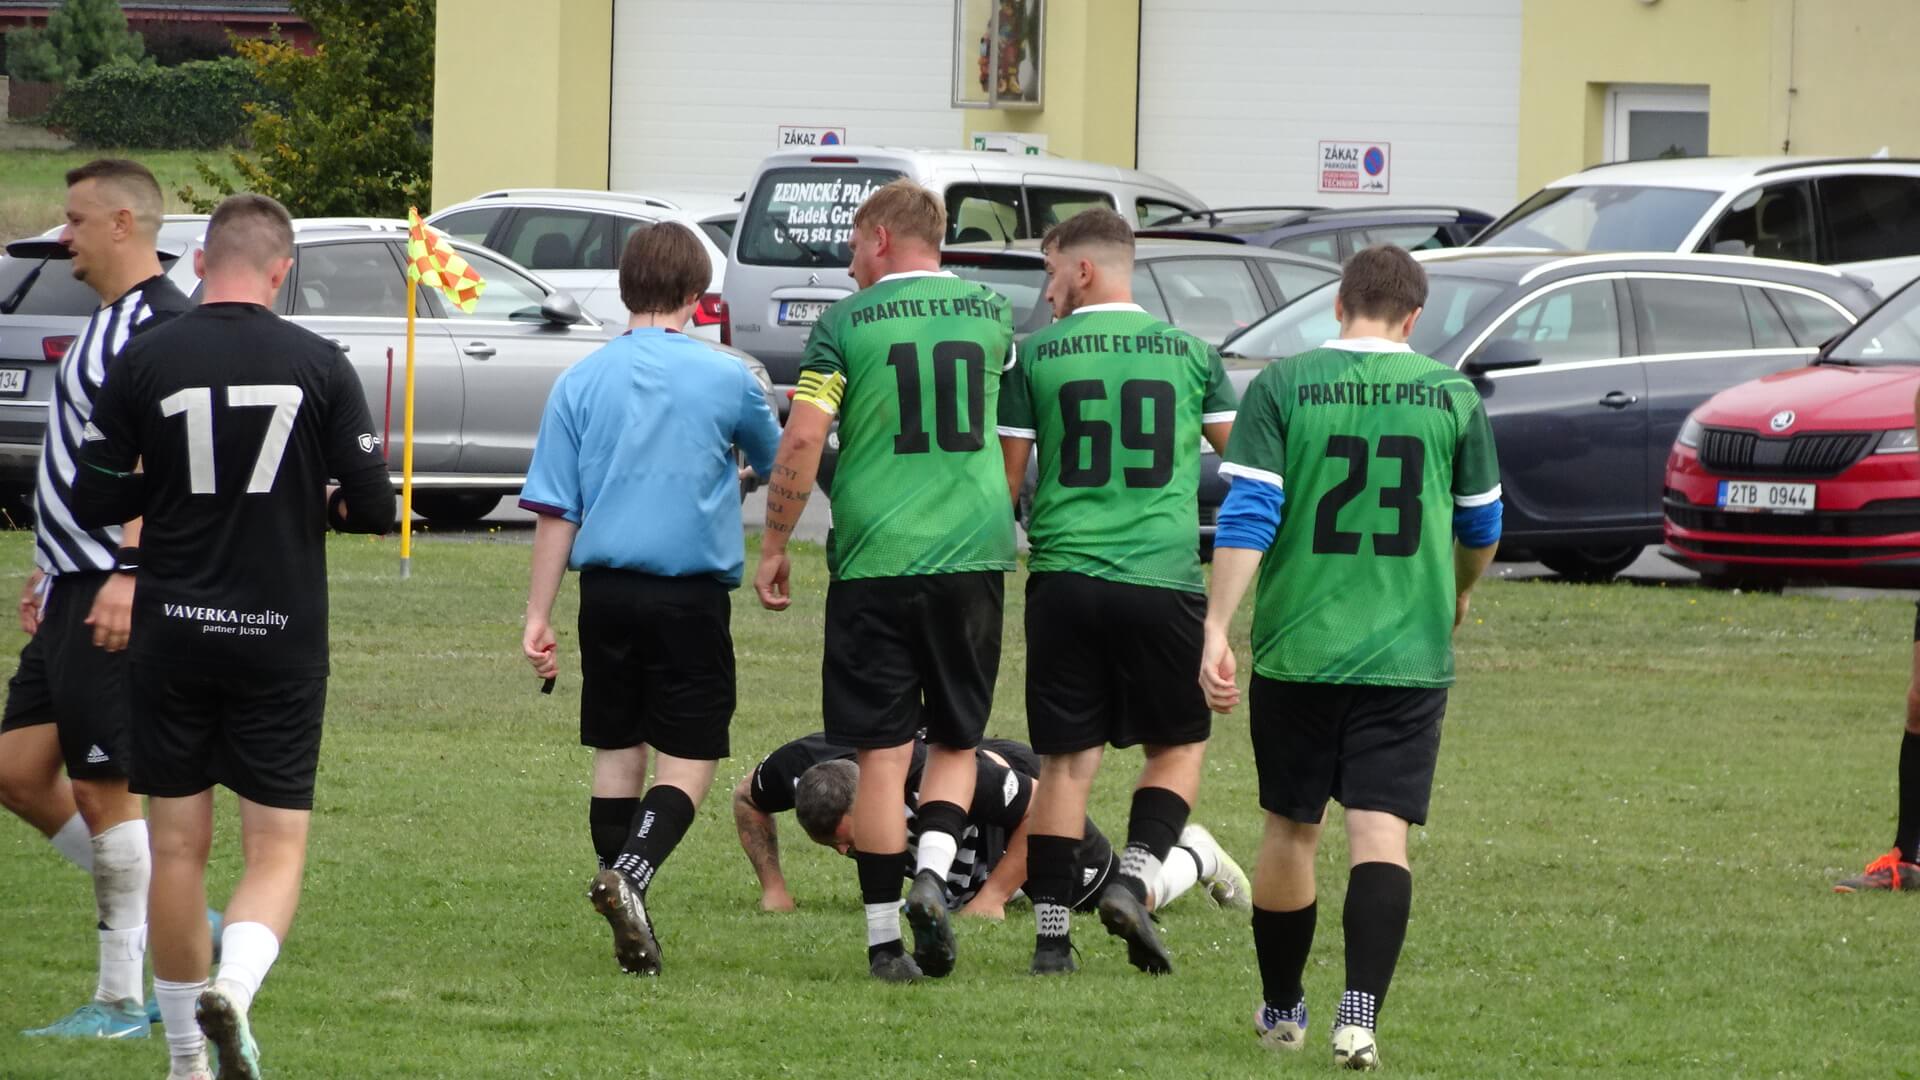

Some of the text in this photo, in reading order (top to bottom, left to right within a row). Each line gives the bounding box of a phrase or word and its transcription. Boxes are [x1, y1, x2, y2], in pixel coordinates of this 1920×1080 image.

[783, 129, 817, 145] ZÁKAZ
[1324, 144, 1359, 161] ZÁKAZ
[774, 178, 842, 202] ZEDNICKÉ
[787, 205, 829, 224] Radek
[811, 226, 832, 243] 581
[851, 300, 926, 328] PRAKTIC
[928, 299, 950, 317] FC
[1037, 334, 1109, 361] PRAKTIC
[1112, 335, 1133, 353] FC
[886, 341, 985, 455] 10
[1298, 381, 1369, 407] PRAKTIC
[1372, 383, 1391, 405] FC
[160, 384, 304, 495] 17
[1058, 378, 1177, 488] 69
[1312, 434, 1426, 557] 23
[1730, 484, 1807, 506] 2TB 0944
[164, 603, 289, 631] VAVERKA reality
[202, 624, 268, 636] partner JUSTO
